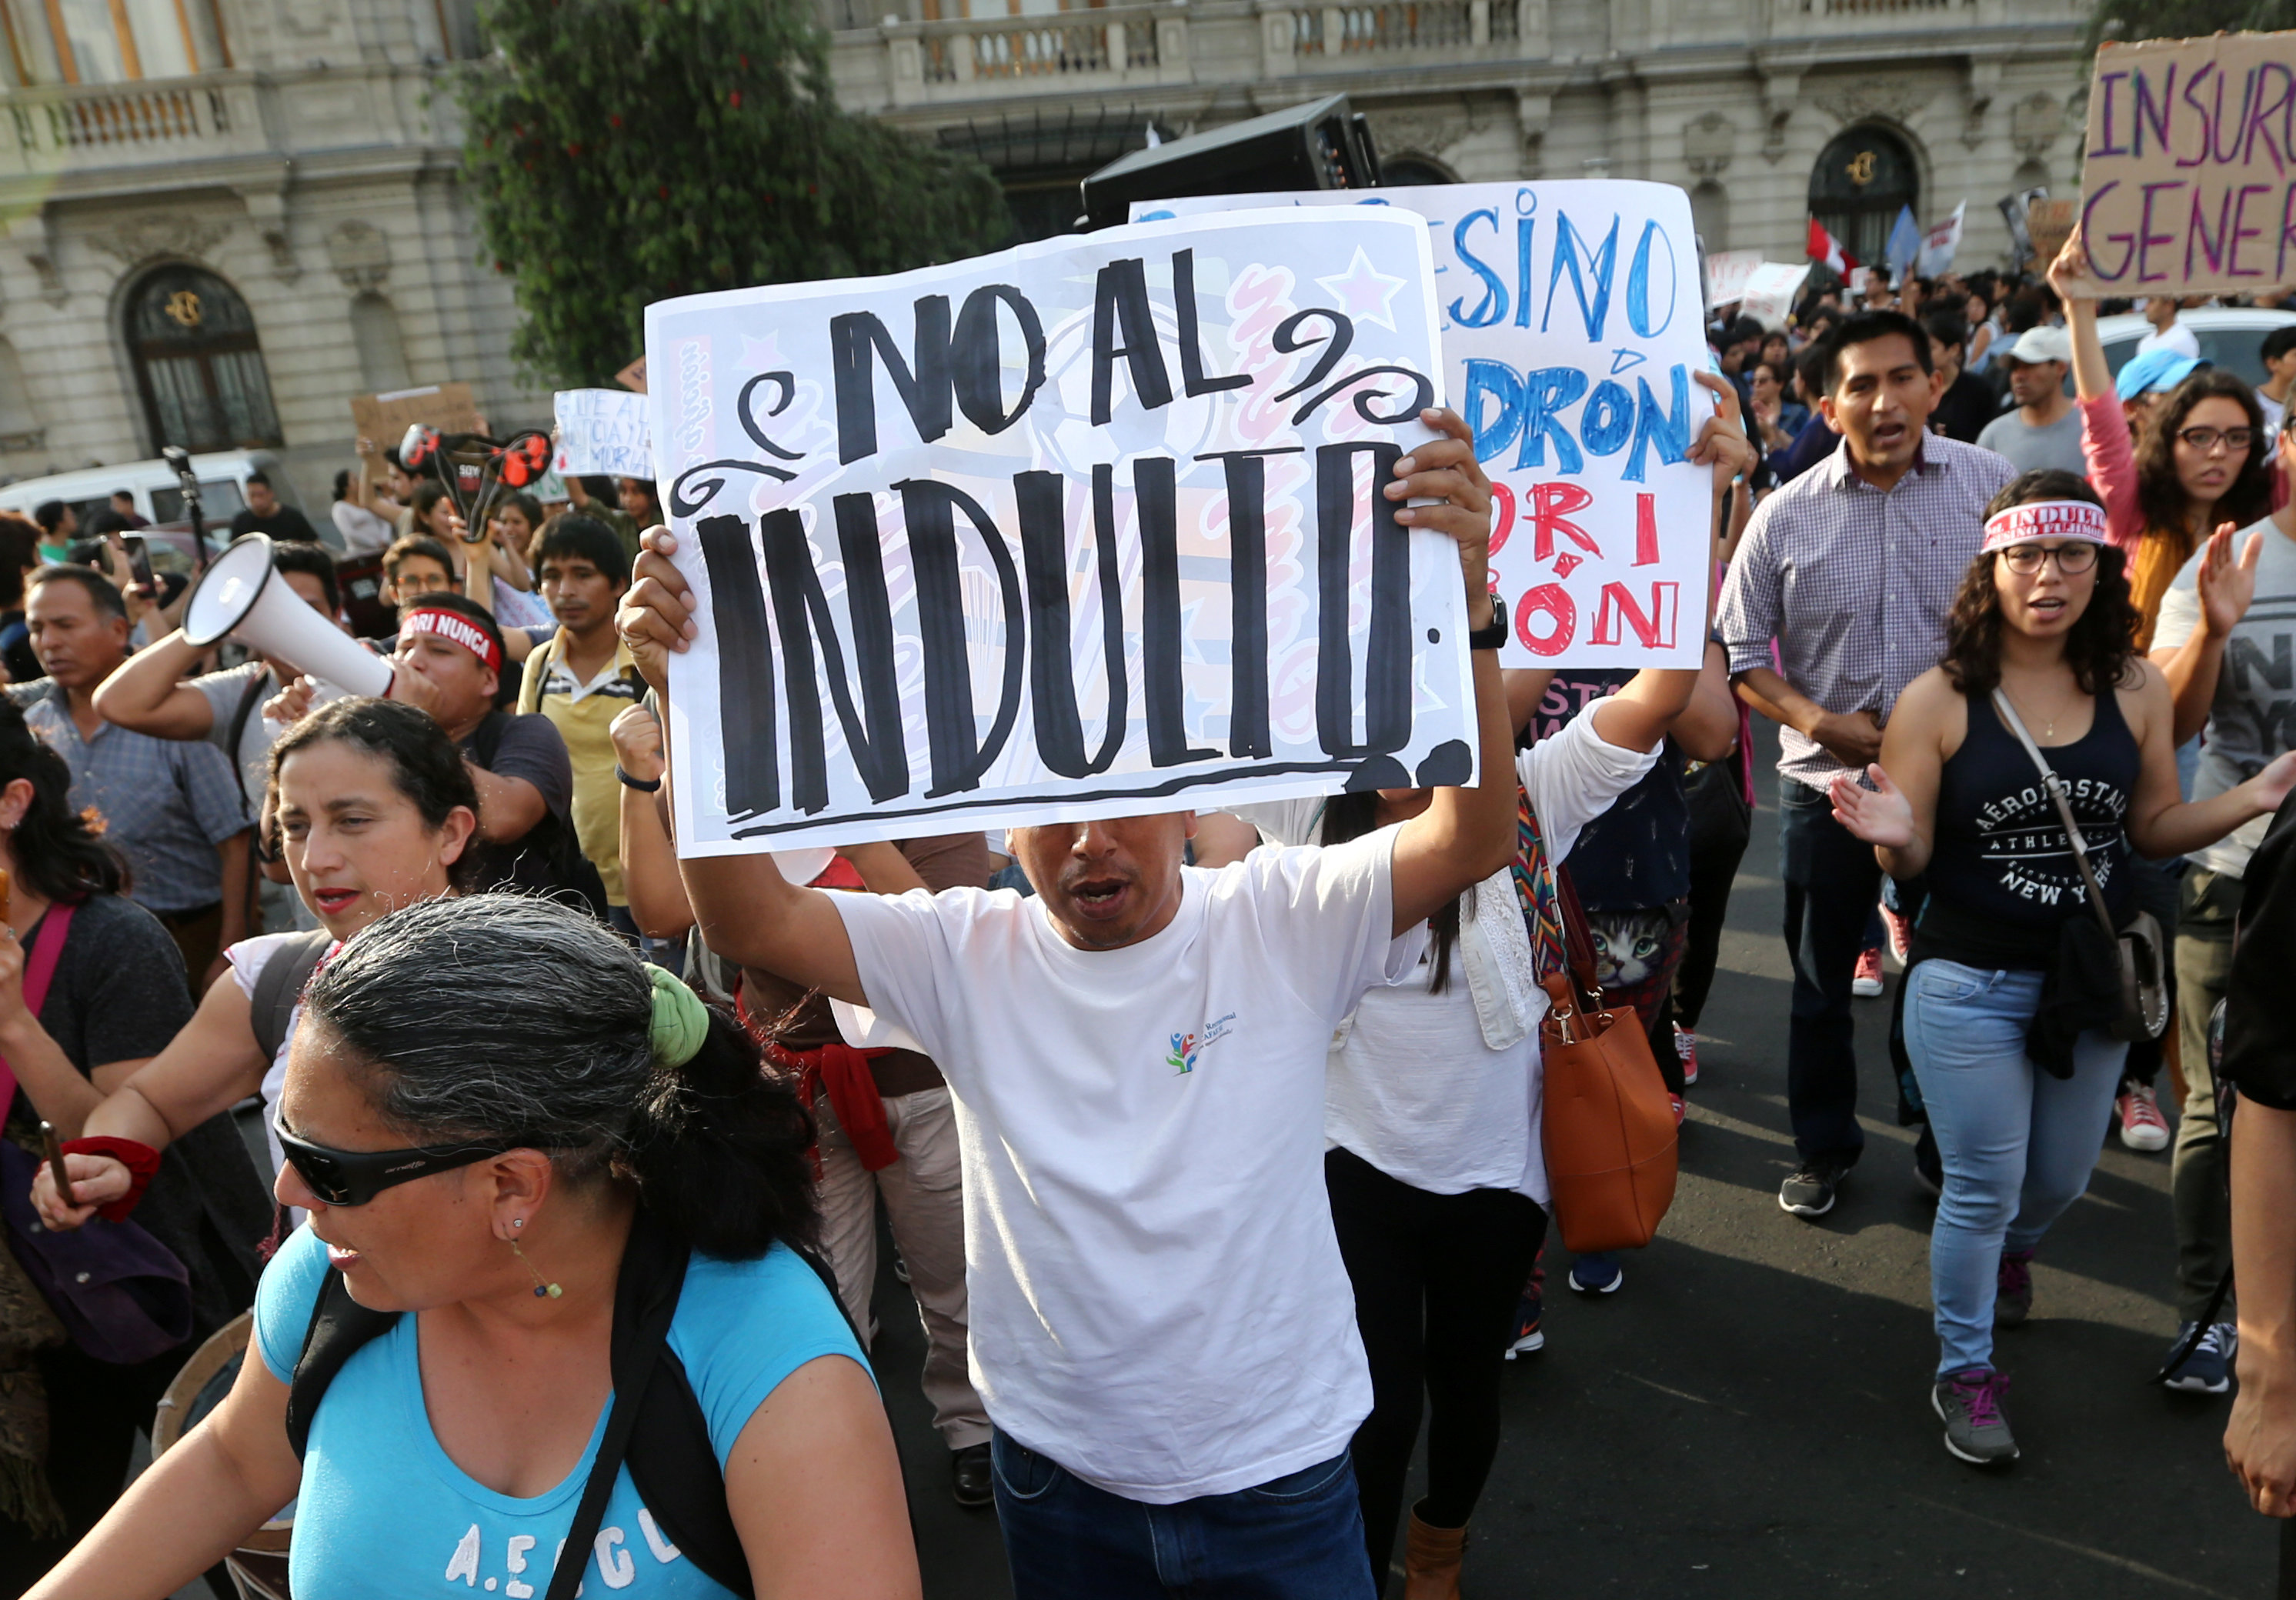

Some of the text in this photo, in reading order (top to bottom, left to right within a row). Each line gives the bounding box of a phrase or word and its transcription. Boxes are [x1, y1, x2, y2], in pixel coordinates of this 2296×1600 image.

[2087, 60, 2296, 179] INSUR
[831, 248, 1253, 466] NO AL
[1460, 348, 1691, 483] DRÓN
[436, 614, 490, 659] NUNCA
[696, 441, 1411, 823] INDULTO
[1487, 552, 1680, 656] ÓN
[1999, 855, 2114, 906] NEW YRK
